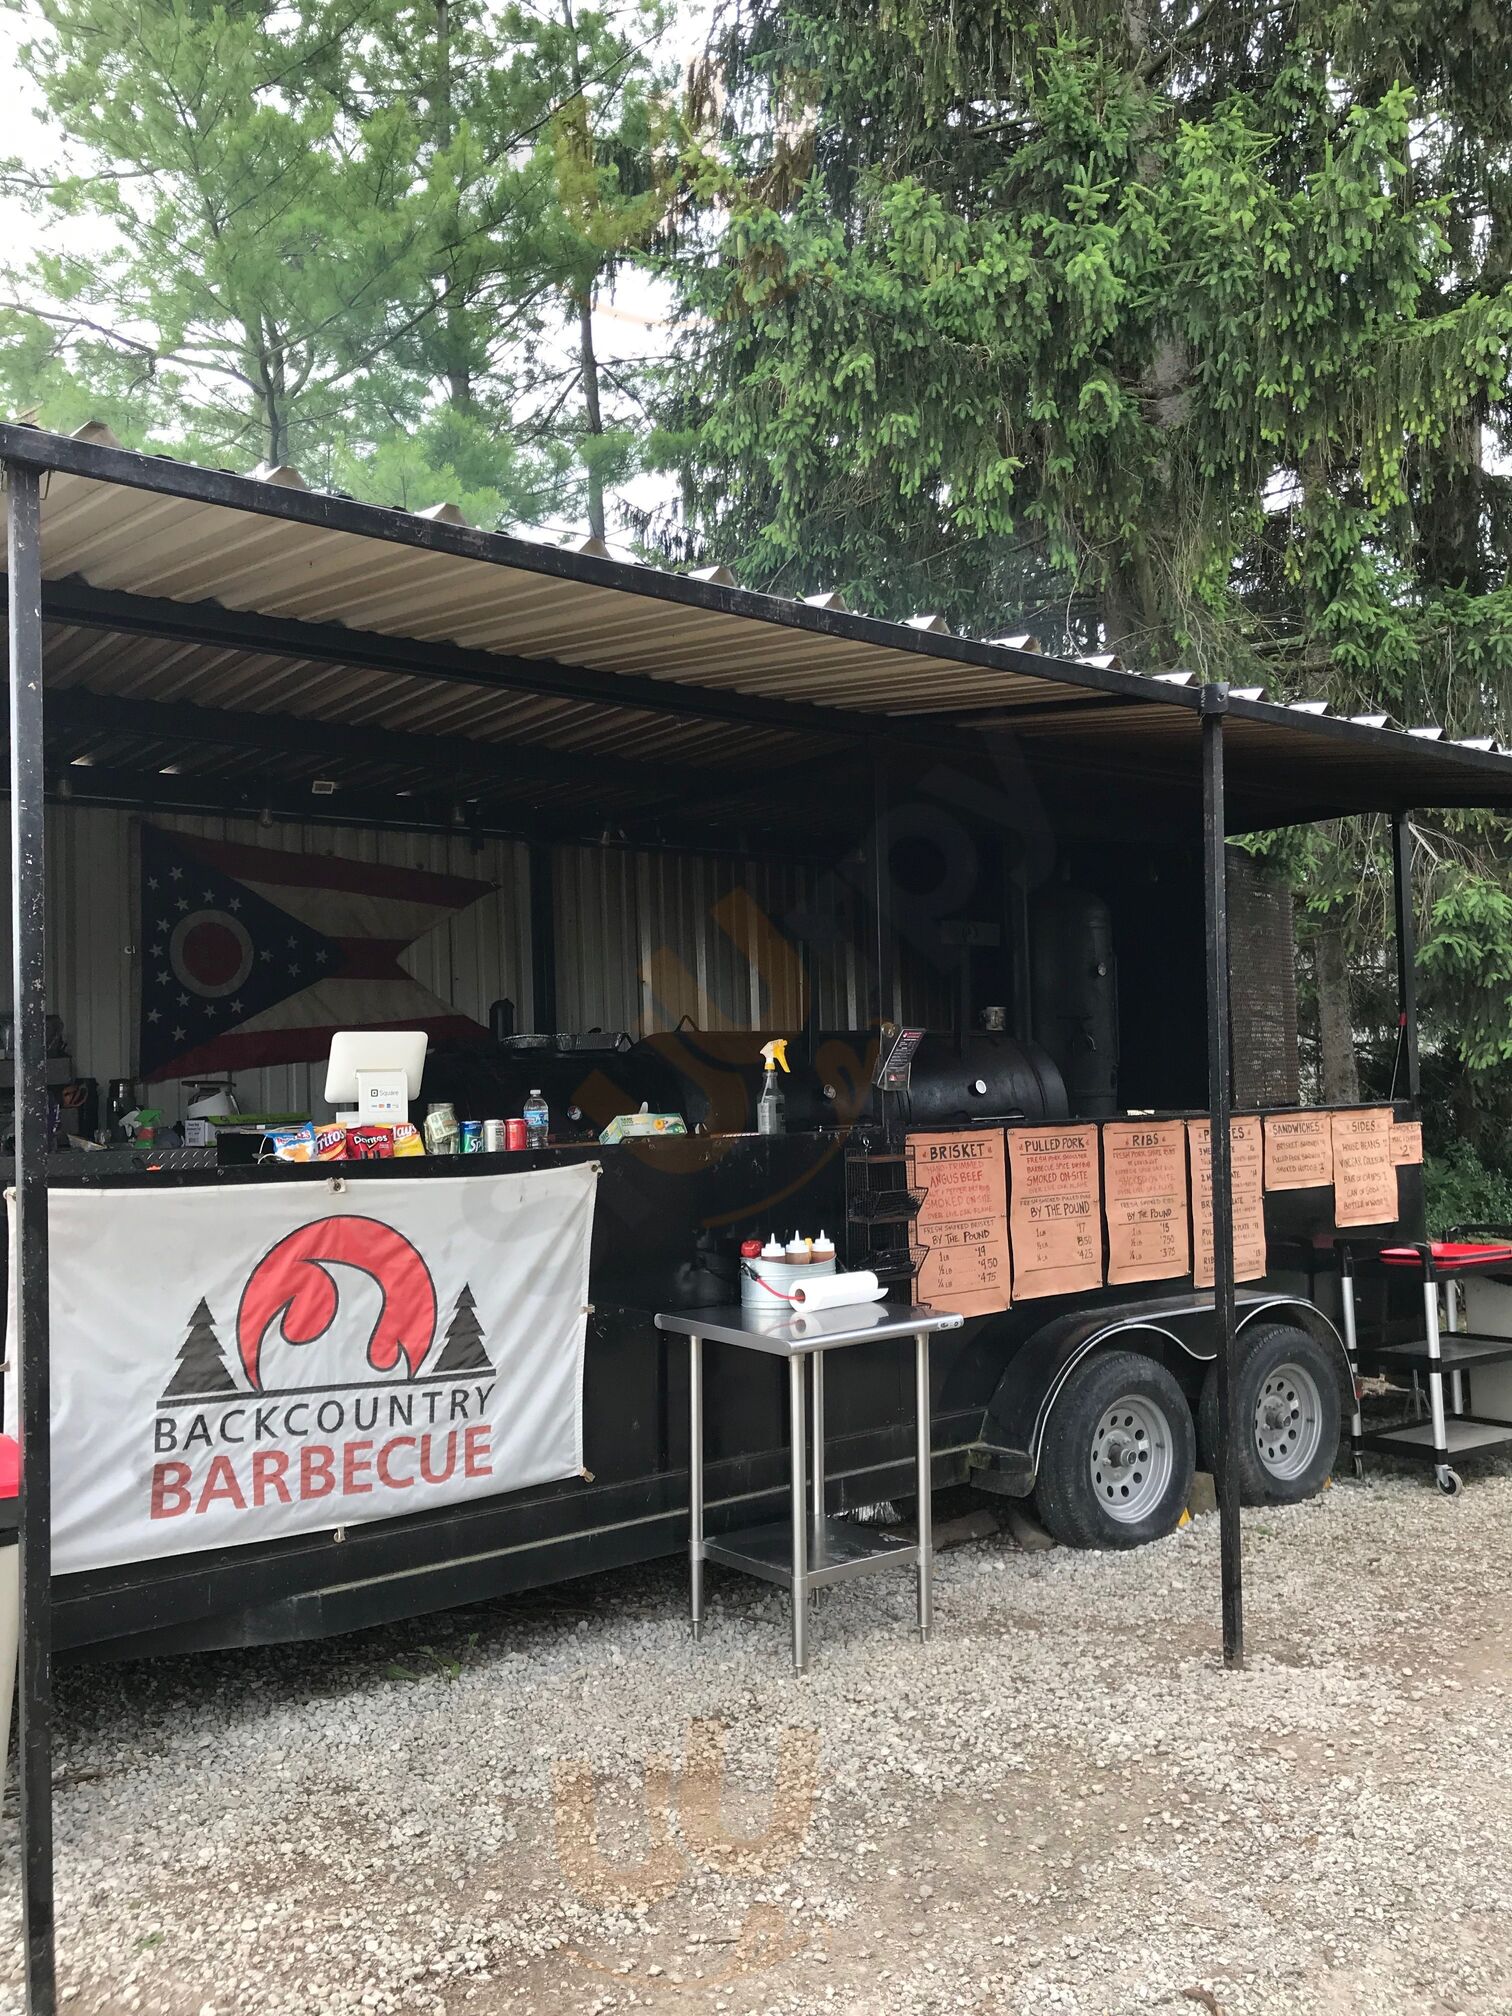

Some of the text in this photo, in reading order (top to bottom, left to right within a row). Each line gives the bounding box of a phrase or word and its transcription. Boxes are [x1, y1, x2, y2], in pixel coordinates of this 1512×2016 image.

[1203, 1126, 1245, 1141] PES
[1272, 1121, 1320, 1136] SANDWICHES
[1351, 1120, 1376, 1132] SIDES
[353, 1132, 388, 1148] Doritos
[1024, 1136, 1085, 1153] PULLED PORK
[1132, 1133, 1159, 1147] RIBS
[1341, 1142, 1359, 1151] HOUSE
[1360, 1138, 1381, 1150] BEANS
[930, 1143, 985, 1160] BRISKET
[1026, 1155, 1047, 1165] FRESH
[930, 1170, 983, 1188] ANGUS BEEF
[1026, 1170, 1088, 1187] SMOKED ON-SITE
[1346, 1188, 1358, 1197] CAN
[925, 1195, 964, 1210] SMOKED
[1030, 1201, 1090, 1219] BY THE POUND
[1127, 1208, 1172, 1221] BY THE POUND
[923, 1219, 994, 1235] FRESH SMOKED BRISKET
[932, 1229, 990, 1245] BY THE POUND
[154, 1383, 495, 1454] BACKCOUNTRY
[150, 1425, 494, 1520] BARBECUE
